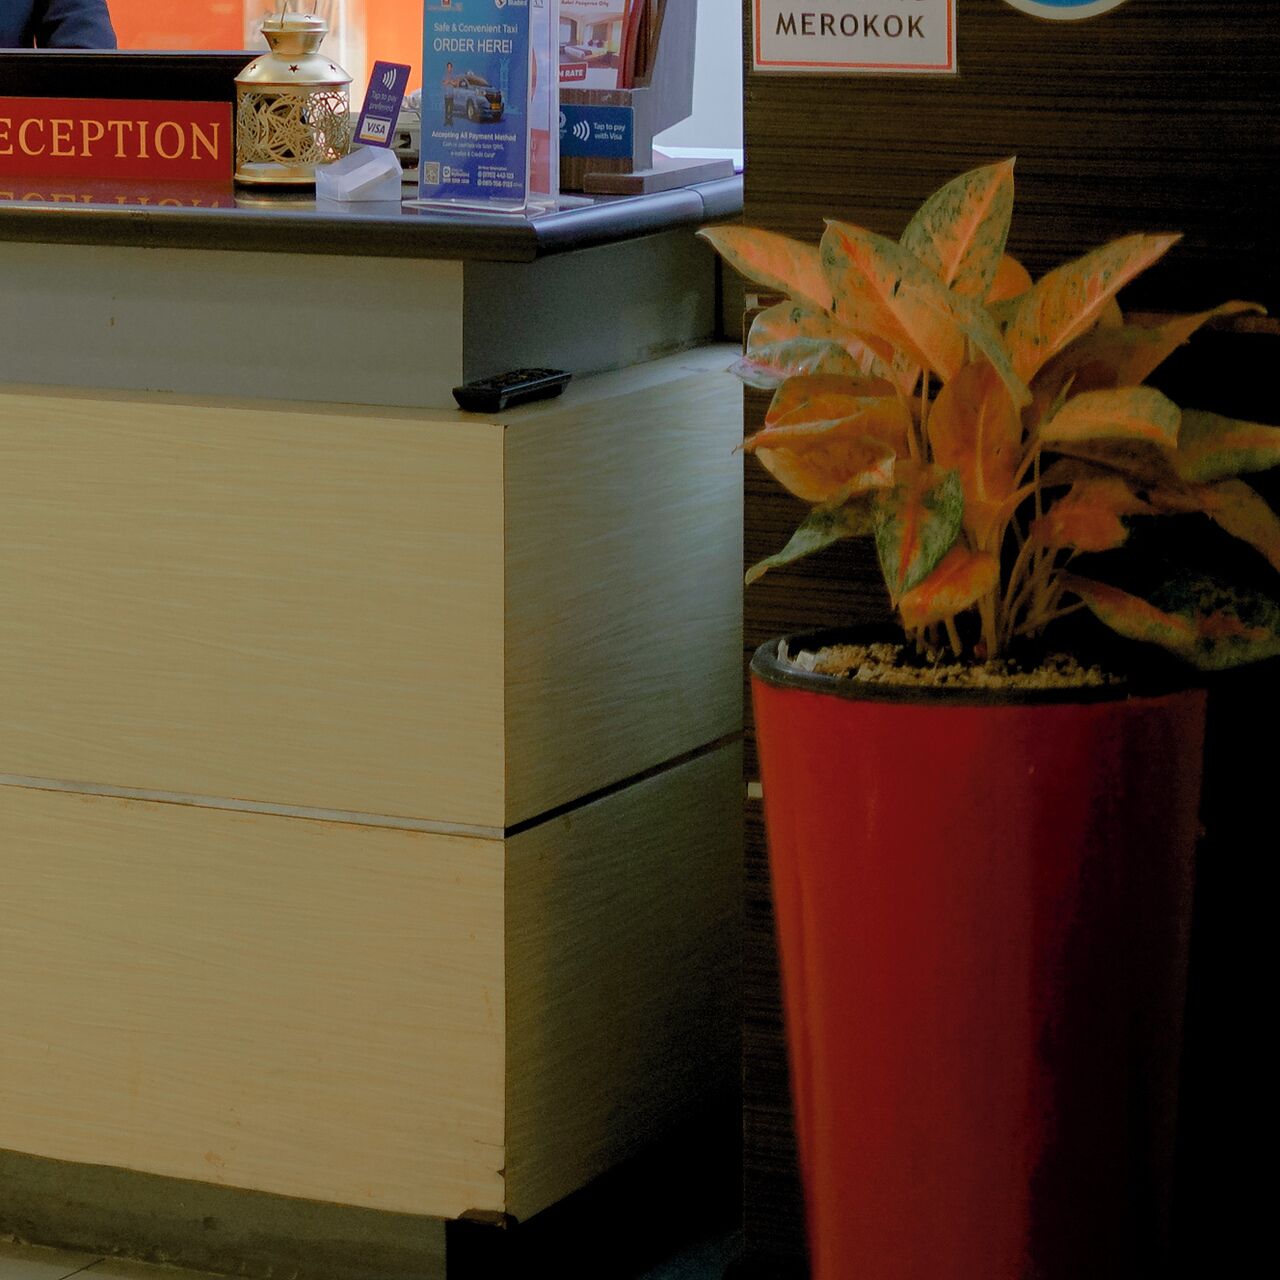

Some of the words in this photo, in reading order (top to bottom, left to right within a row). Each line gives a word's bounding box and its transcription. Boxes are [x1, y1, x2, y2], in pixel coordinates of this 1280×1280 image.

[433, 22, 450, 32] Safe
[452, 23, 458, 32] &
[458, 23, 502, 33] Convenient
[503, 23, 518, 33] Taxi
[775, 12, 926, 39] MEROKOK
[433, 37, 475, 52] ORDER
[477, 39, 513, 54] HERE!
[565, 69, 583, 77] RATE
[371, 90, 381, 100] Tap
[381, 92, 387, 100] to
[387, 93, 397, 103] pay
[368, 102, 394, 113] preferred
[367, 122, 386, 135] VISA
[593, 122, 604, 132] Tap
[605, 123, 613, 131] to
[613, 124, 626, 132] pay
[431, 130, 459, 140] Accepting
[460, 131, 468, 139] All
[468, 132, 494, 141] Payment
[494, 133, 517, 142] Method
[594, 131, 609, 139] with
[609, 132, 623, 140] Visa
